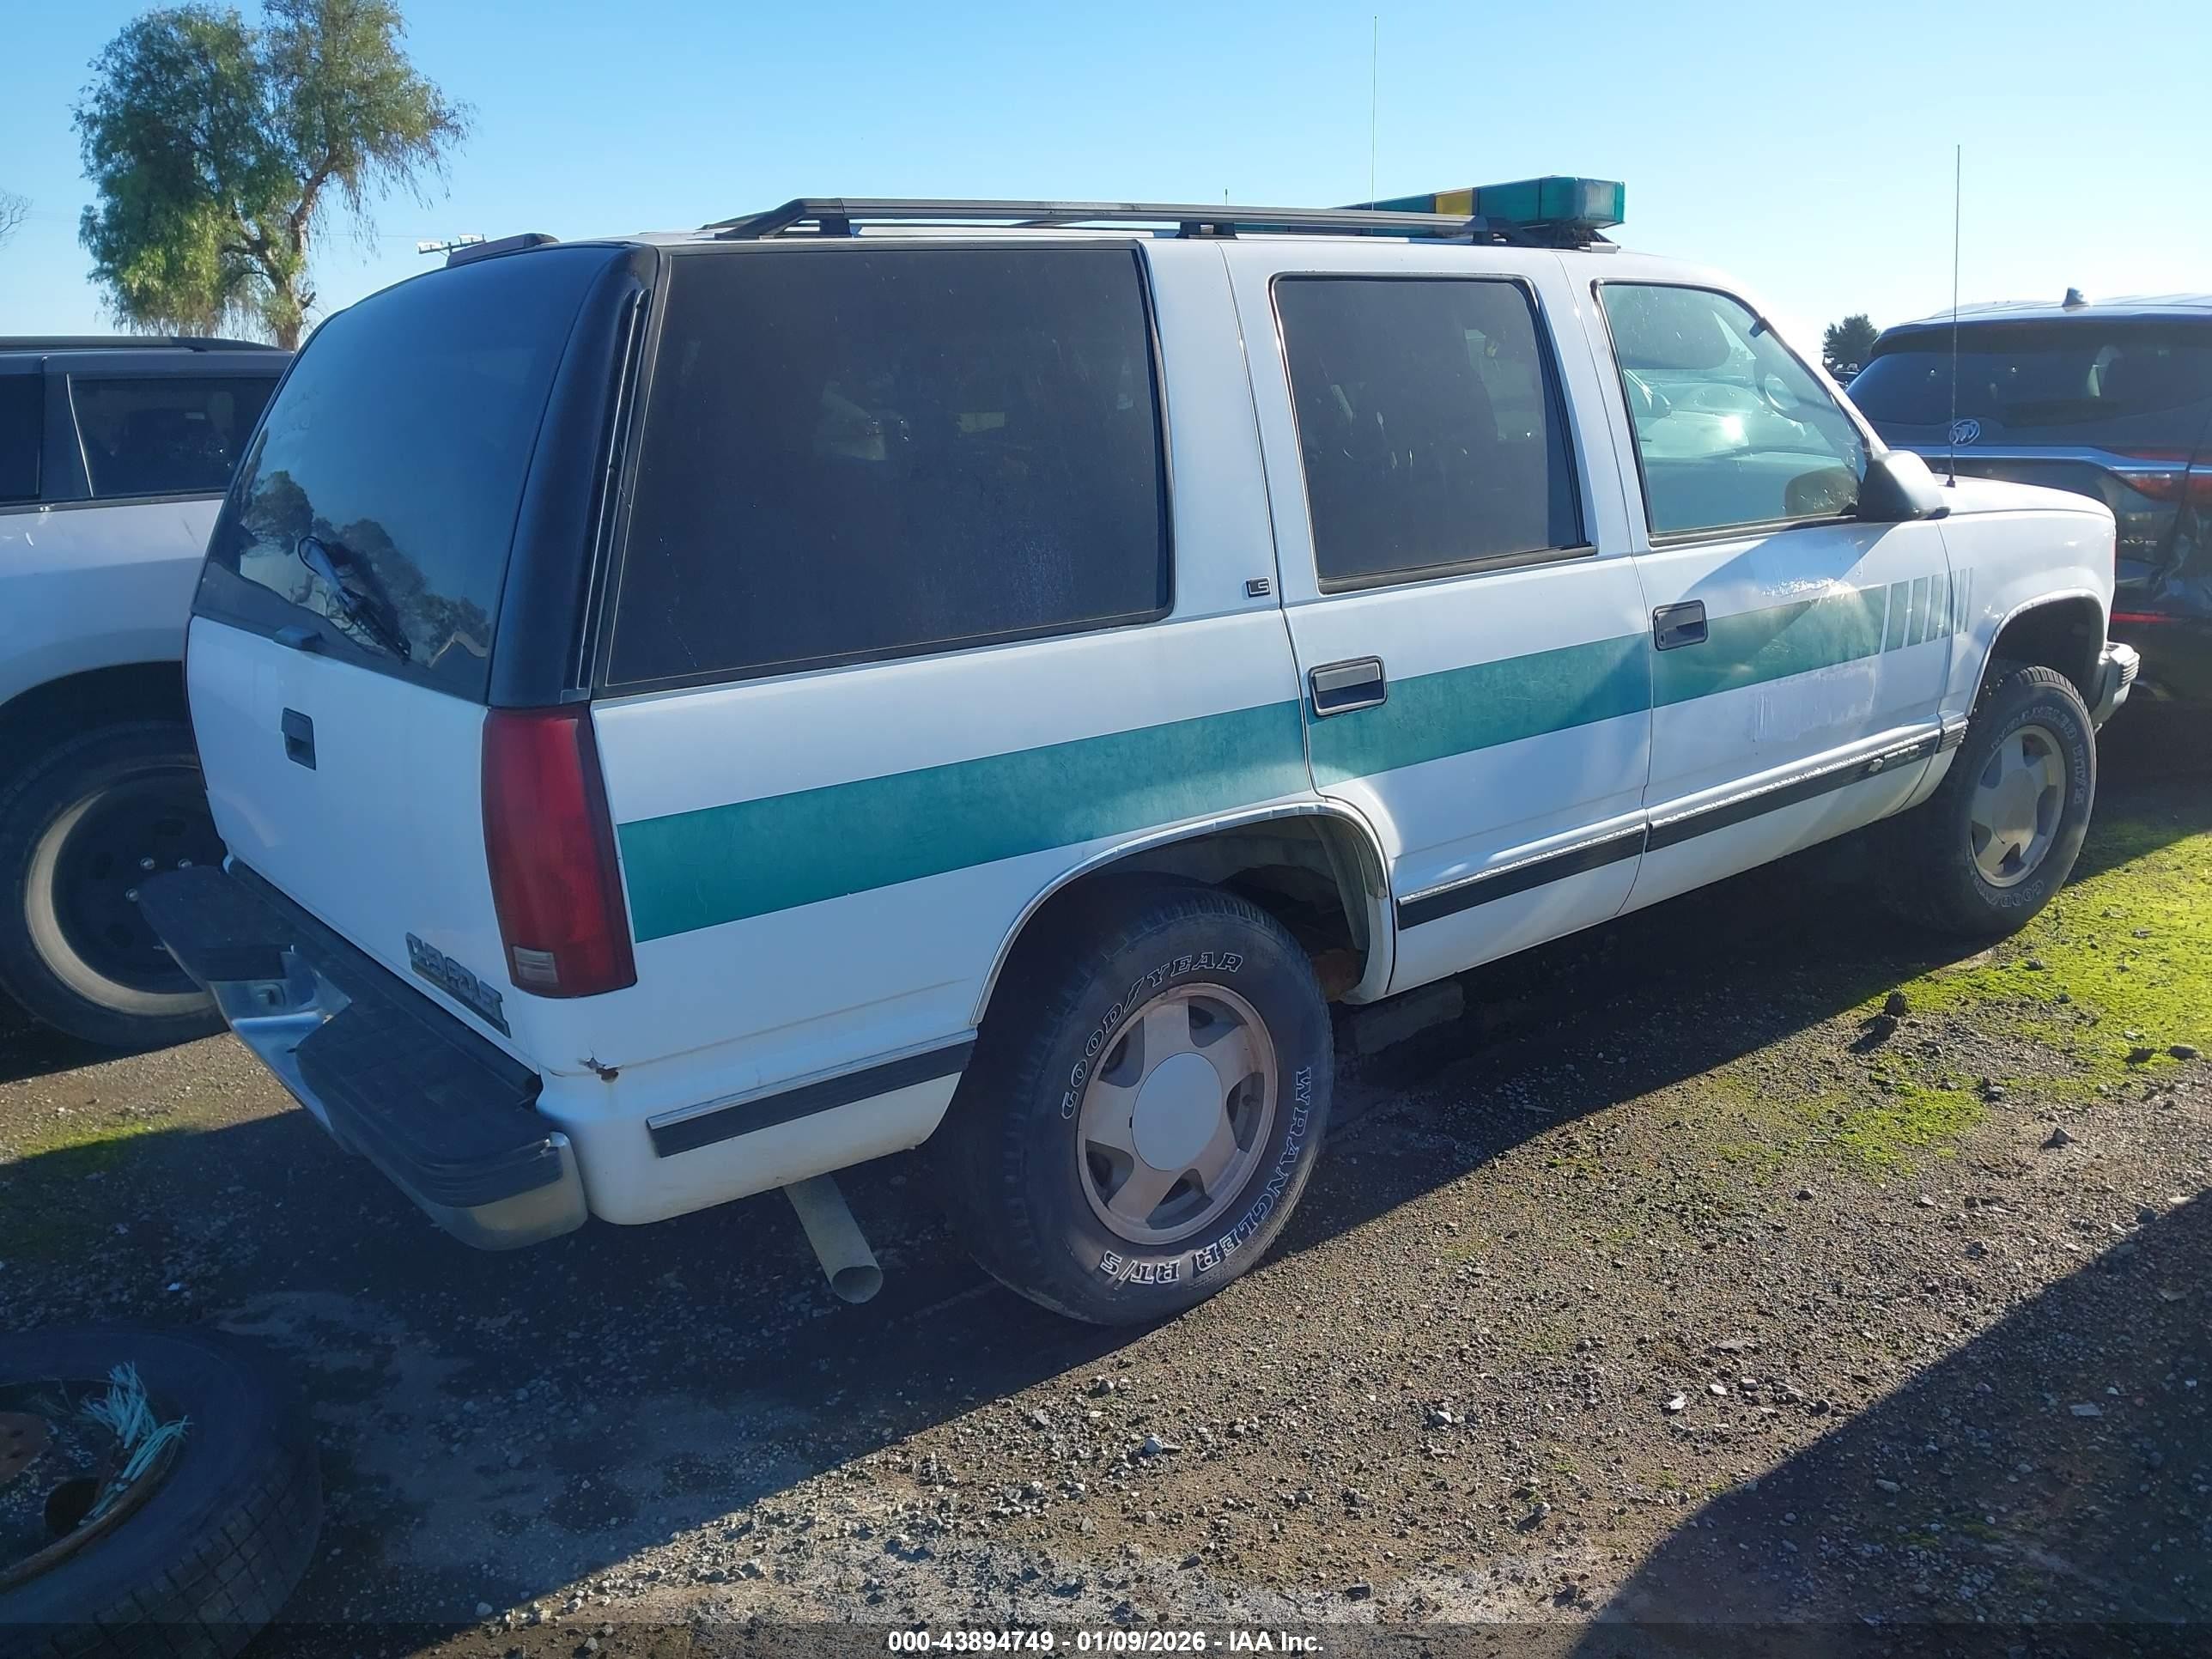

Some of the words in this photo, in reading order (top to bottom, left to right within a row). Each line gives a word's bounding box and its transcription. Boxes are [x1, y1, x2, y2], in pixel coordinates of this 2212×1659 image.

[1061, 952, 1243, 1119] GOODYEAR
[1193, 1066, 1312, 1274] WRANGLER
[1099, 1250, 1180, 1291] RT/S
